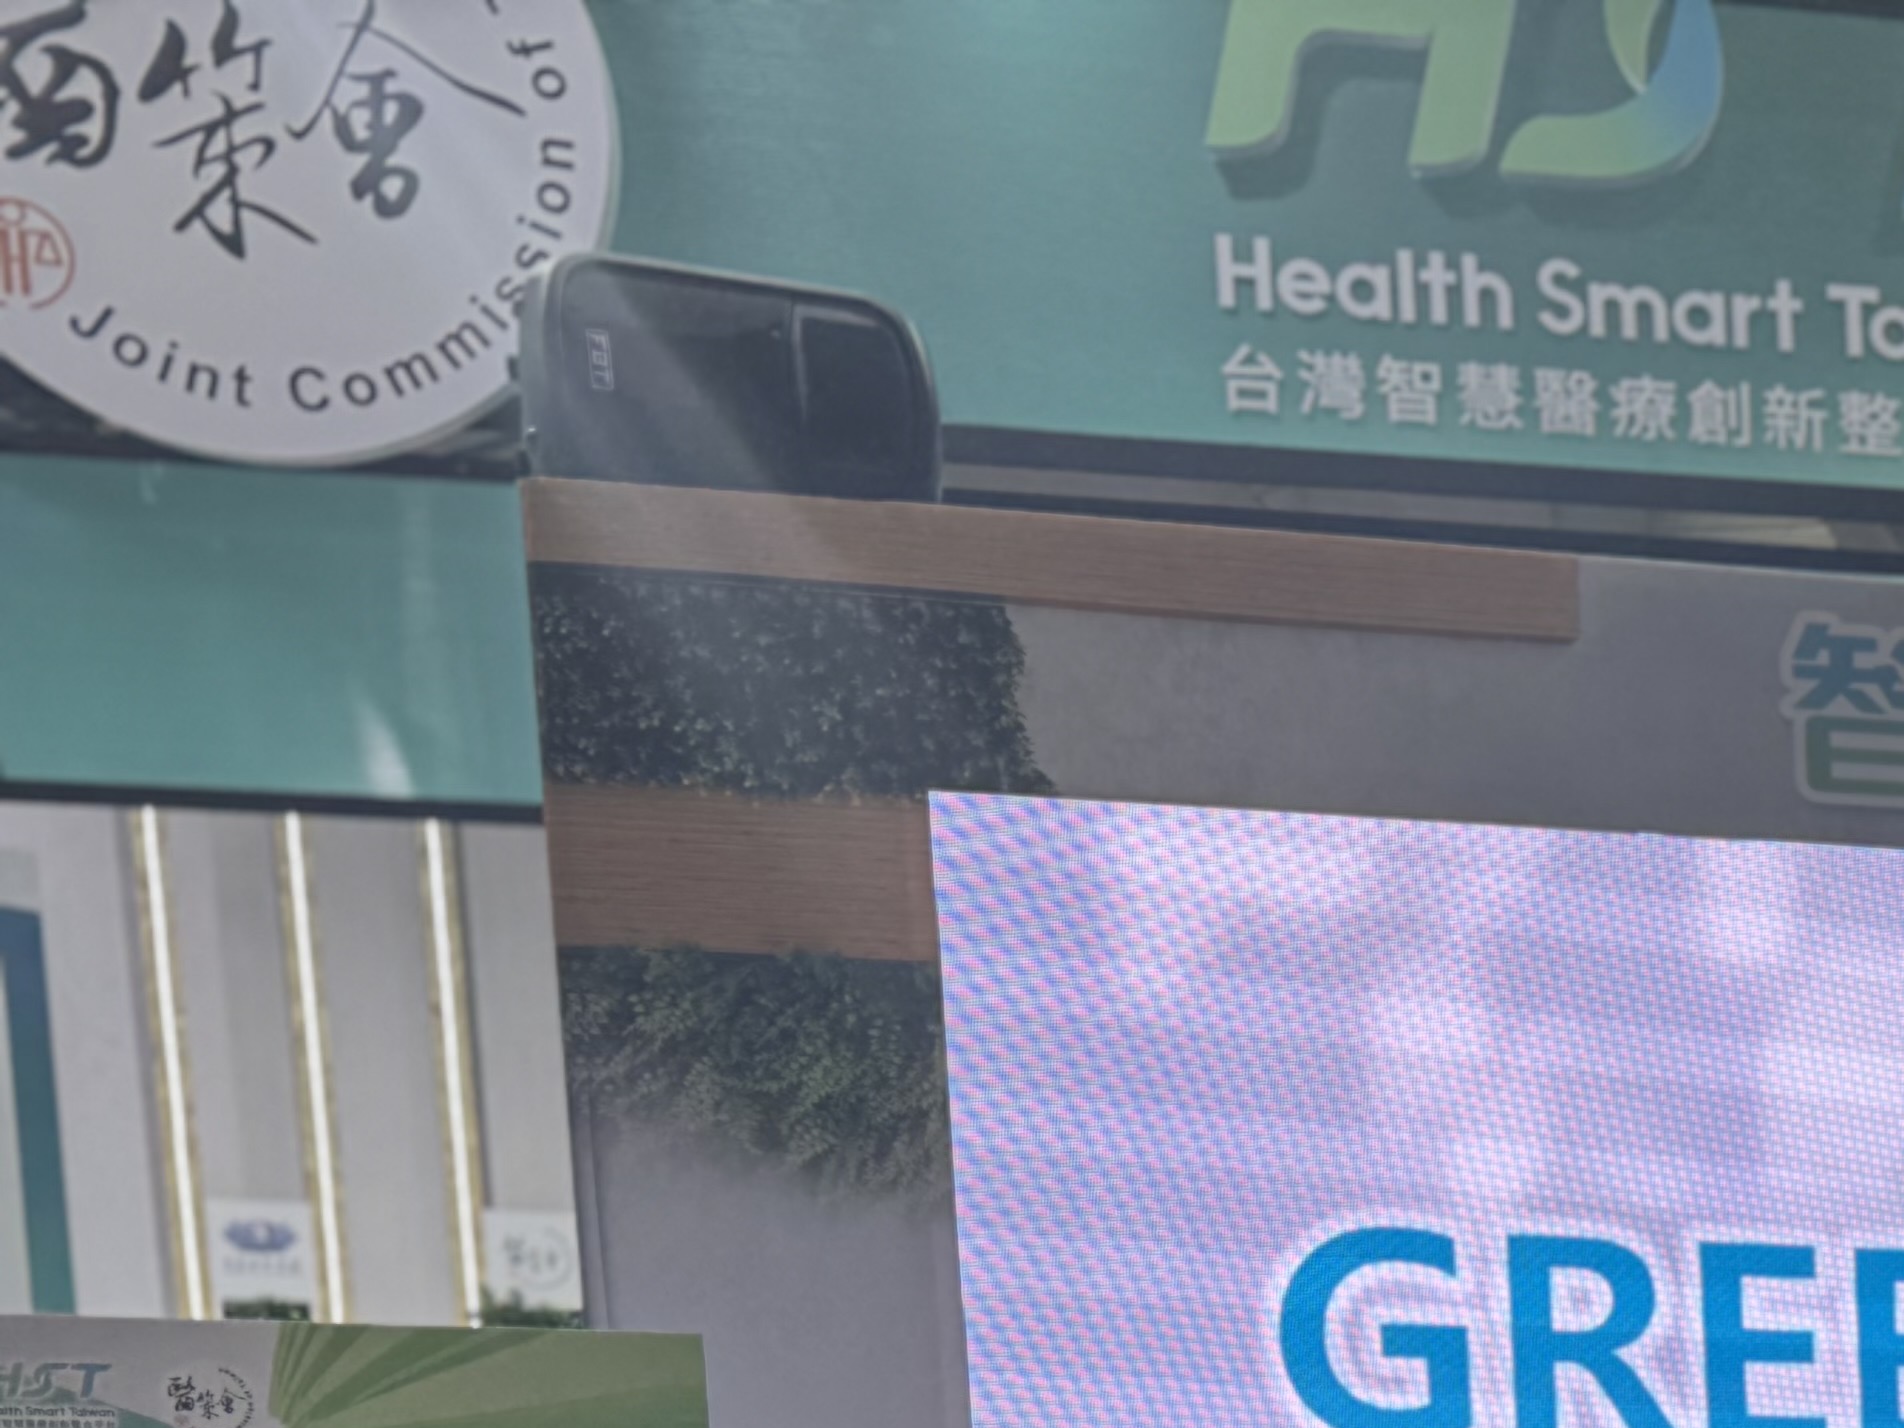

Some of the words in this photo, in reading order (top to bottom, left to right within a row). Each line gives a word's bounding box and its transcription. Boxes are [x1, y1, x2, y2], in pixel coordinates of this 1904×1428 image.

[507, 36, 570, 102] of
[1214, 232, 1516, 332] Health
[1536, 258, 1804, 355] Smart
[68, 304, 254, 408] Joint
